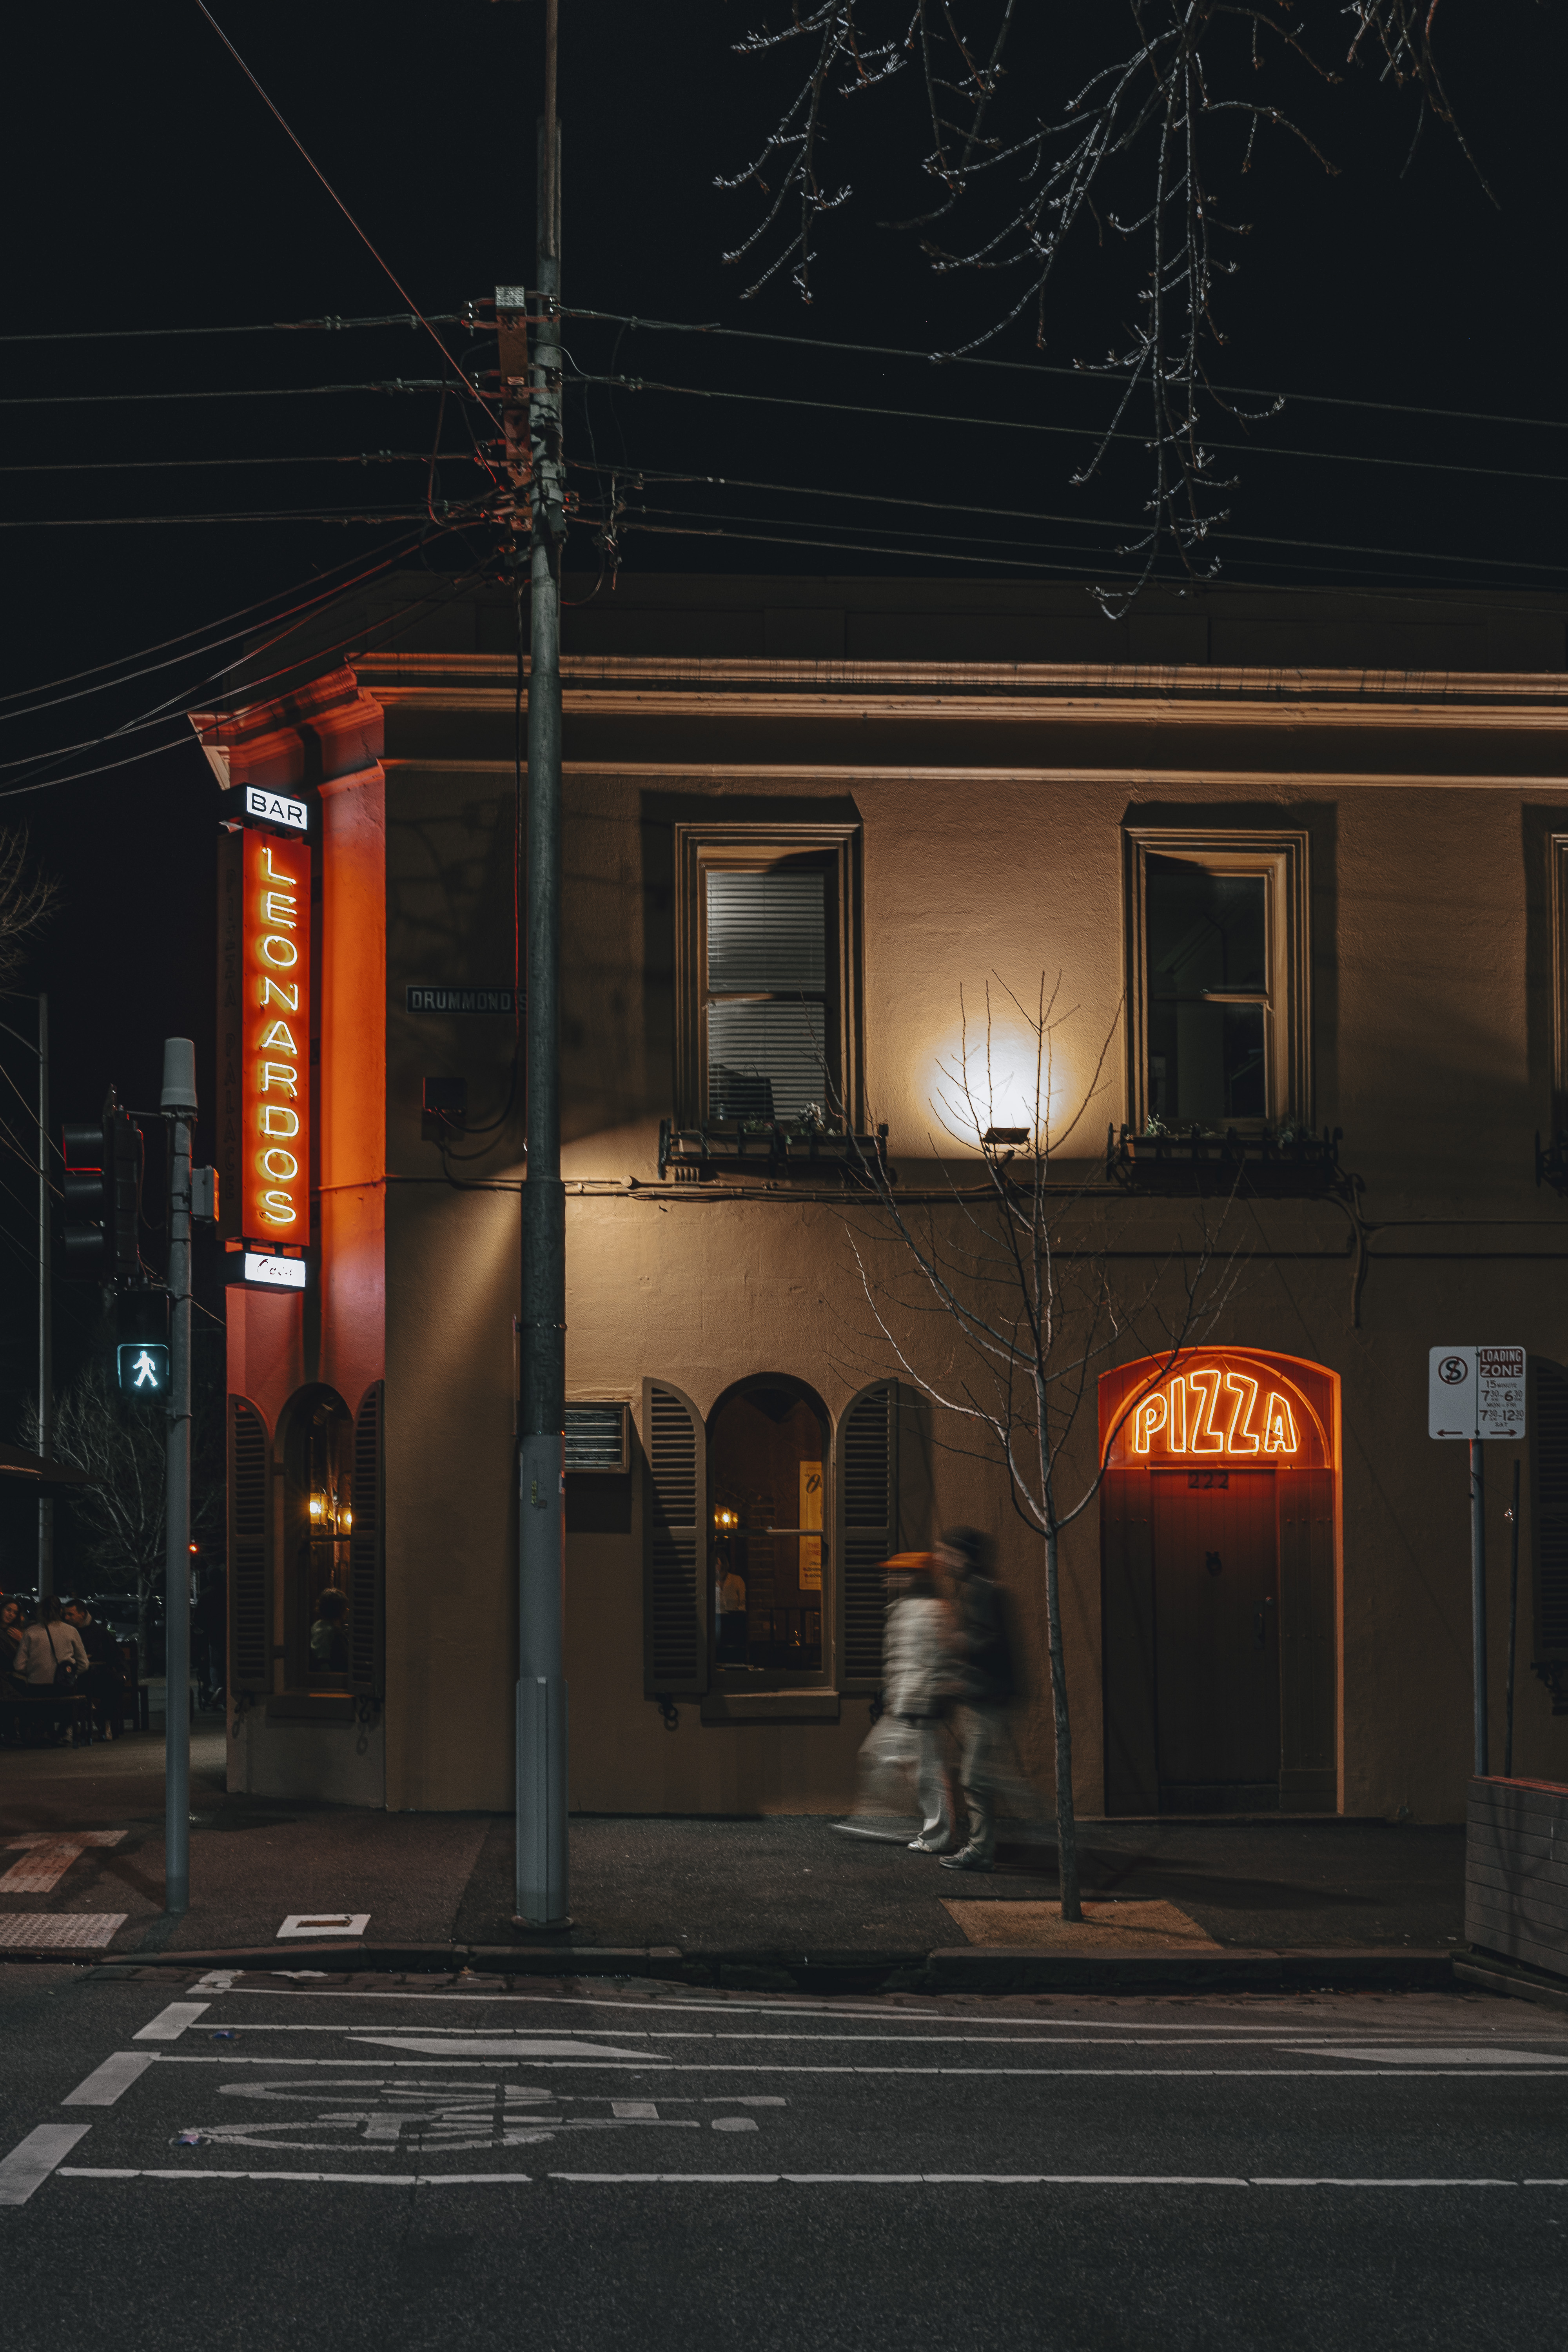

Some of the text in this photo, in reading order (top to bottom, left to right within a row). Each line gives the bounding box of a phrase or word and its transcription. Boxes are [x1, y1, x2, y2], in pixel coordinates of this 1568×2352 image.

[252, 792, 302, 824] BAR
[412, 990, 511, 1011] DRUMMOND
[223, 868, 236, 1199] PIZZA PALACE
[256, 847, 299, 1225] LEONARDOS
[1482, 1350, 1521, 1362] LOADING
[1481, 1364, 1523, 1377] ZONE
[1486, 1380, 1496, 1388] 15
[1135, 1370, 1297, 1454] PIZZA
[1189, 1471, 1228, 1489] 222
